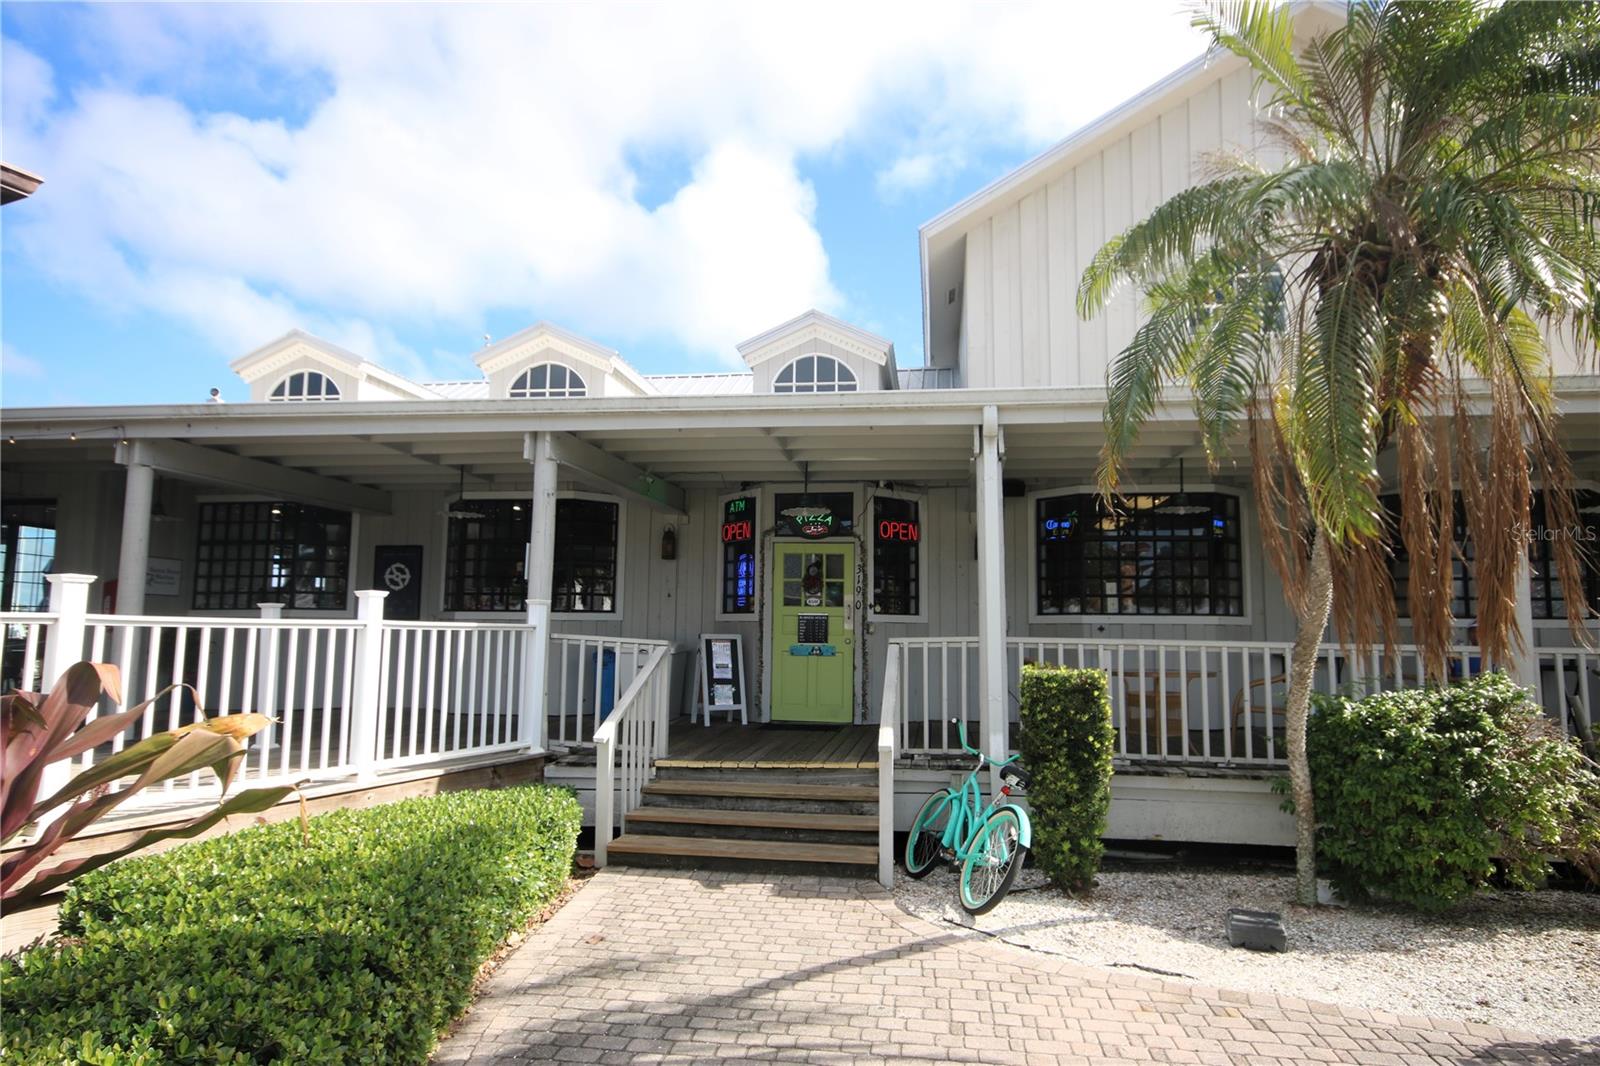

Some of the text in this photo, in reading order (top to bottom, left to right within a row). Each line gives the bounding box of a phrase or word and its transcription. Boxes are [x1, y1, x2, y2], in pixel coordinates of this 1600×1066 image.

[729, 500, 746, 513] ATM
[796, 514, 833, 526] PIZZA
[722, 522, 751, 541] OPEN
[880, 520, 918, 541] OPEN
